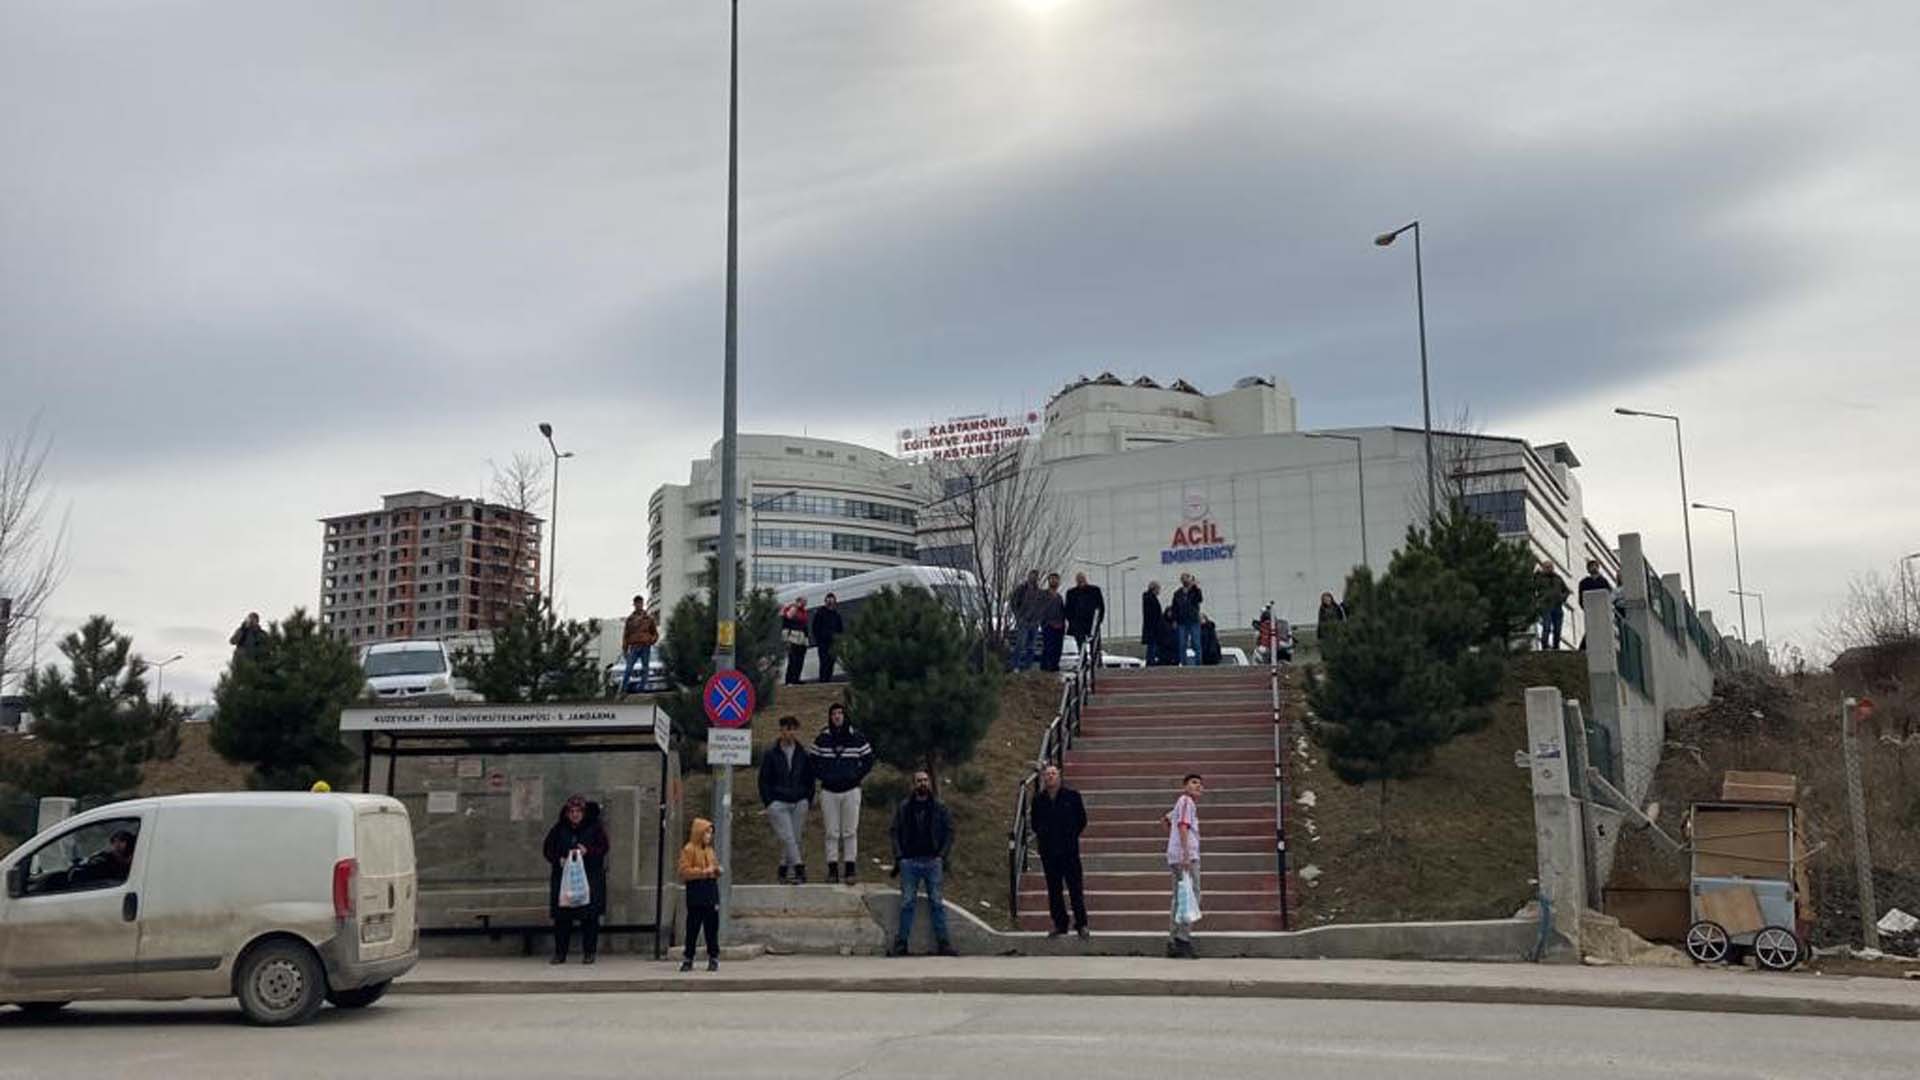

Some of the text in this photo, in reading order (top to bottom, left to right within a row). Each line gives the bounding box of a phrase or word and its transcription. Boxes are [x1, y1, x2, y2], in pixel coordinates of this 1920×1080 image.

[929, 417, 1008, 436] KASTAMONU
[1171, 519, 1224, 548] ACİL
[1161, 544, 1236, 565] EMERGENCY
[374, 714, 425, 724] KUZEYKENT
[567, 712, 616, 721] JANDARMA
